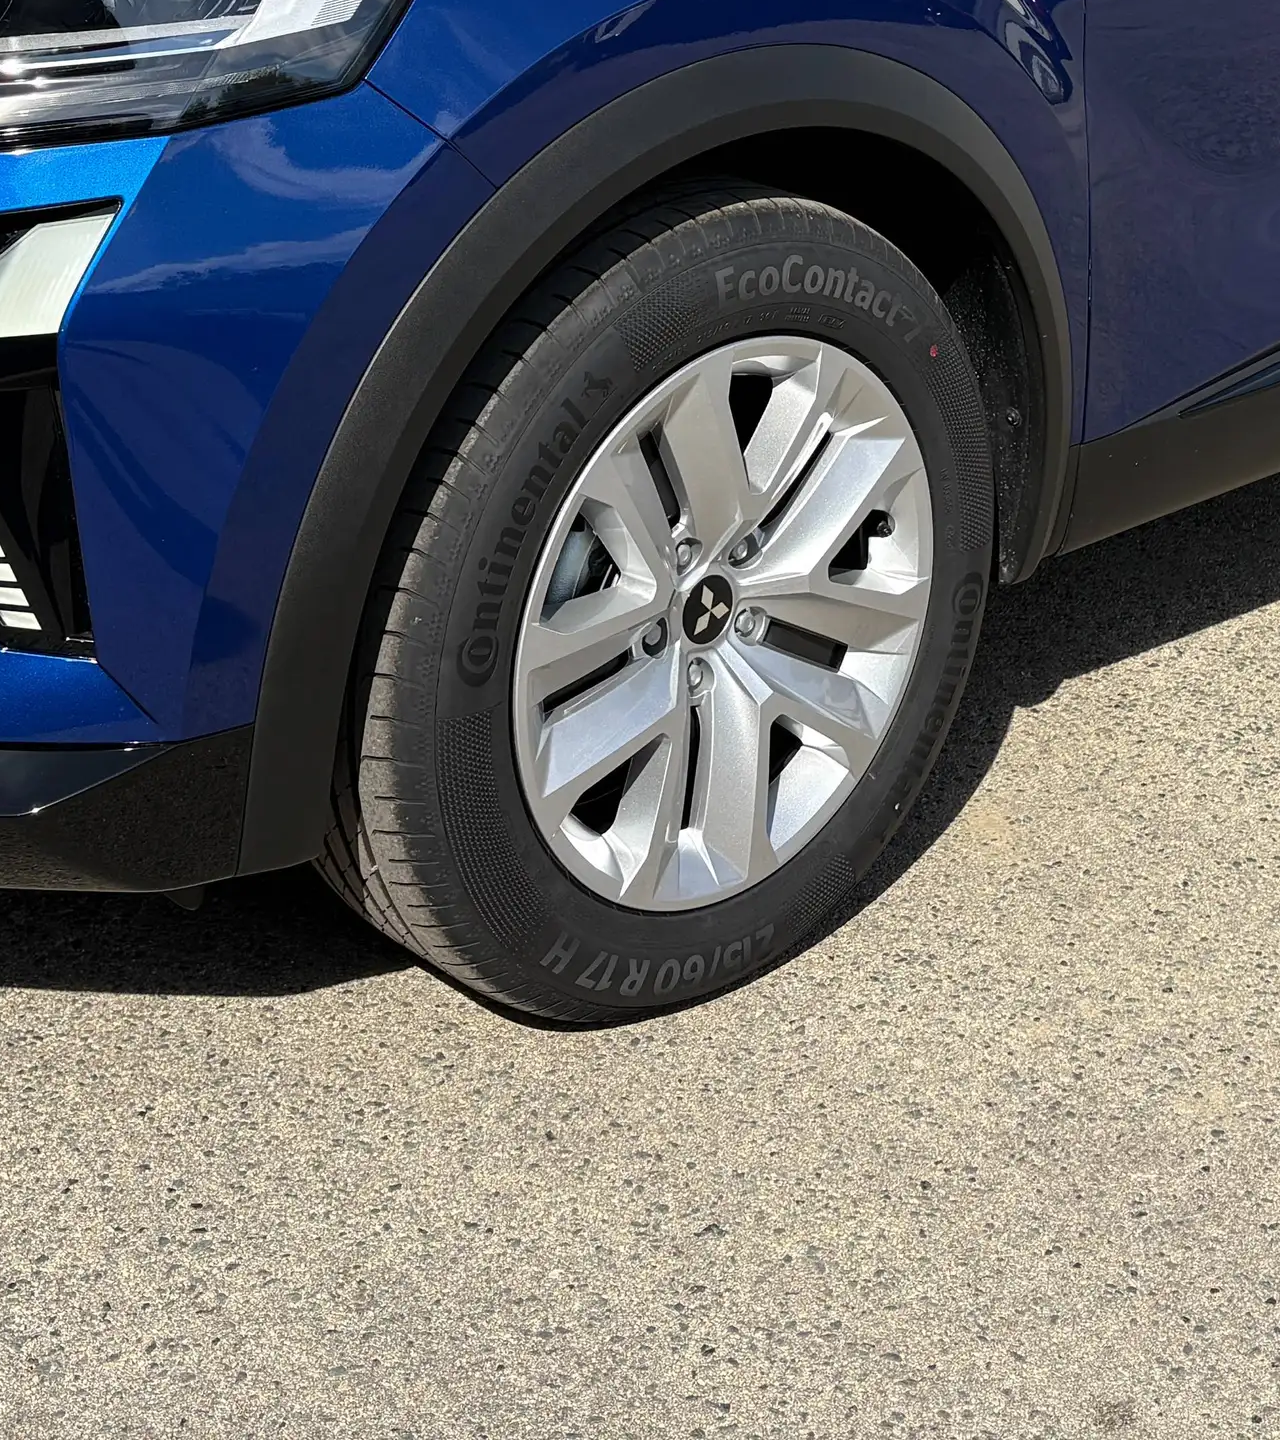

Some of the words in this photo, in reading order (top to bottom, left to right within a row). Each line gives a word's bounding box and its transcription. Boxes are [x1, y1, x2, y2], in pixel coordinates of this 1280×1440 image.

[715, 254, 903, 327] EcoContact
[456, 396, 590, 688] Continental
[539, 931, 581, 975] H
[653, 922, 776, 997] 215/60
